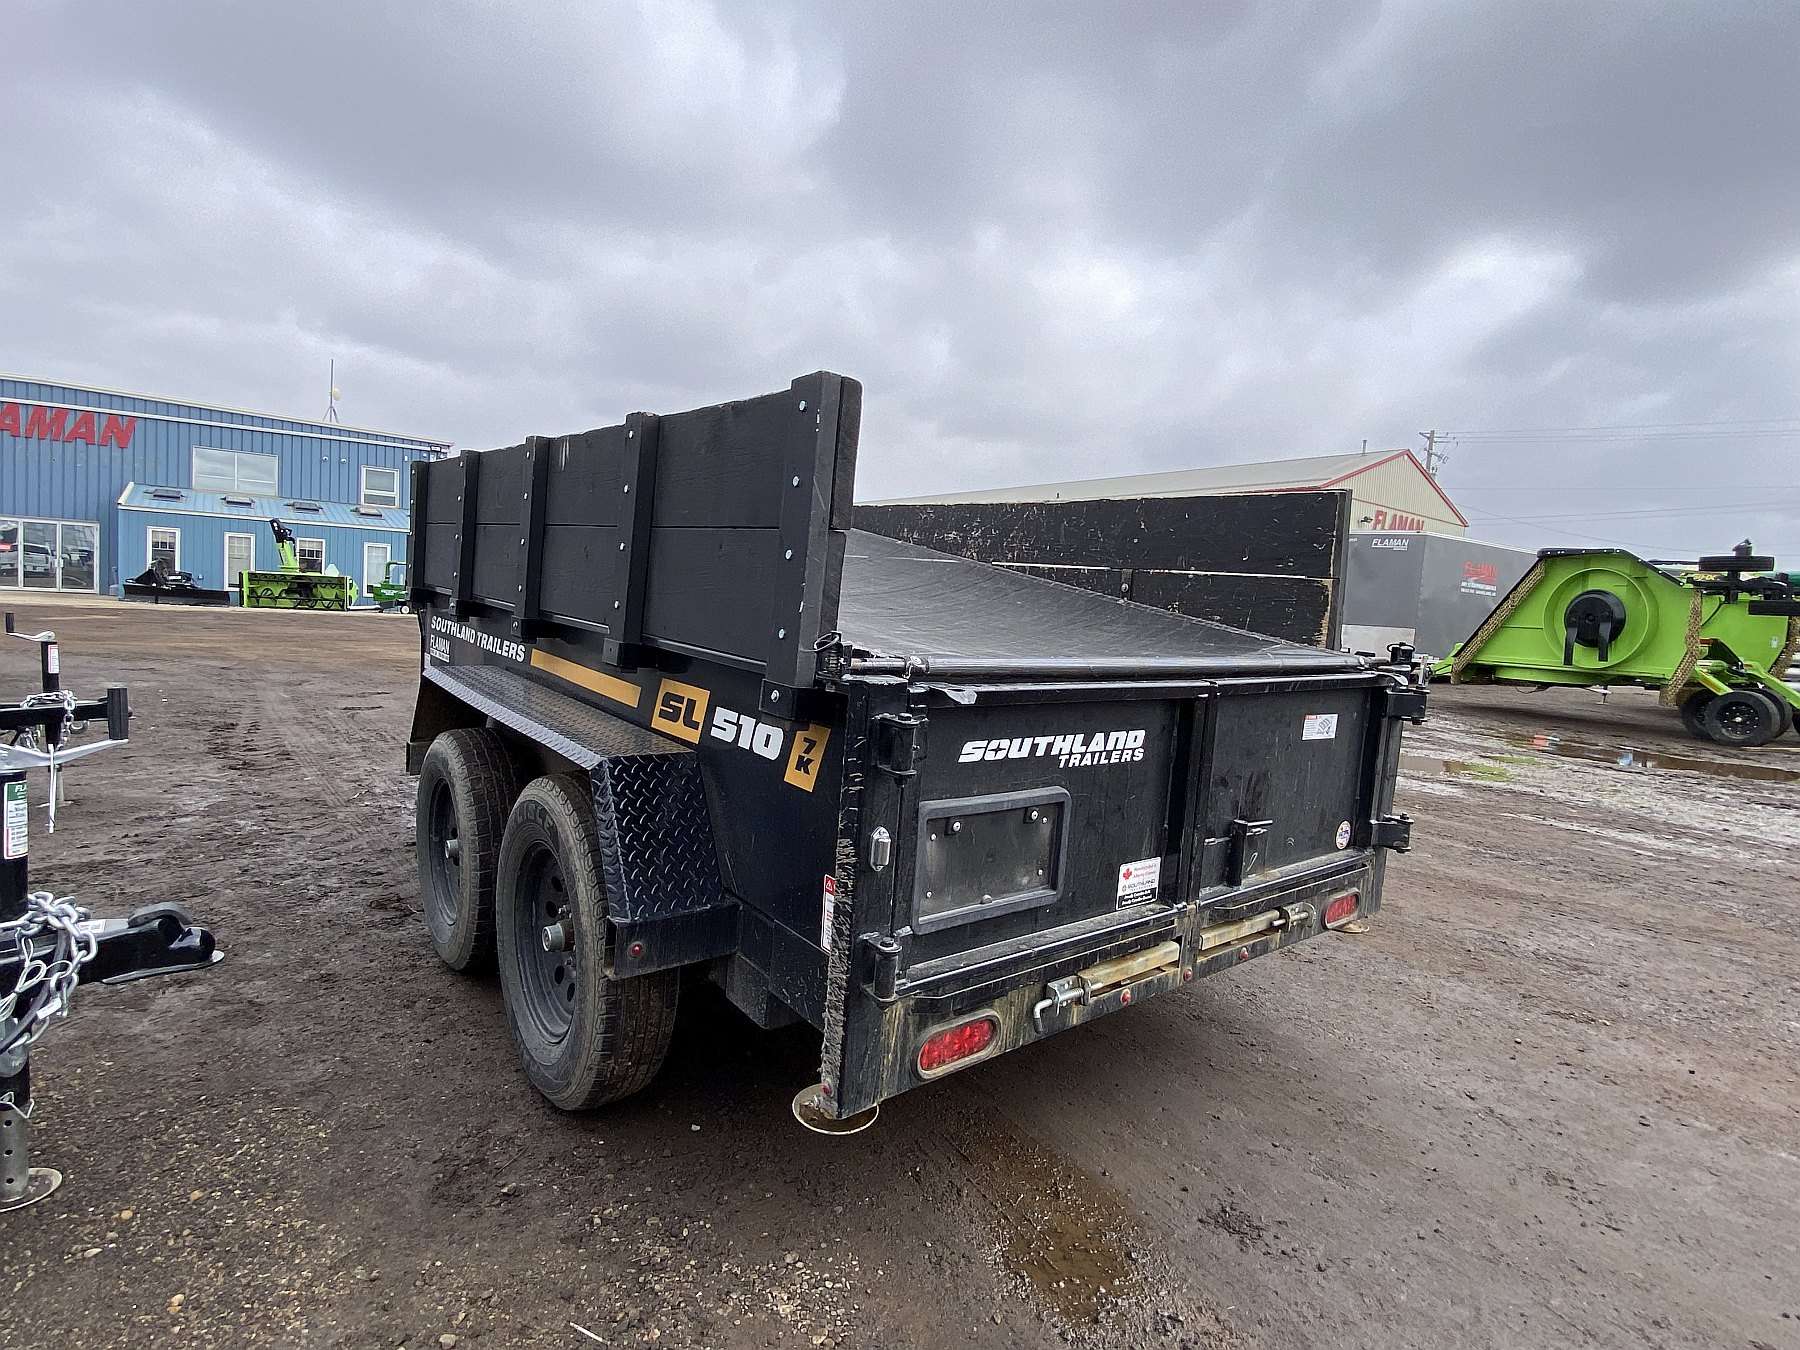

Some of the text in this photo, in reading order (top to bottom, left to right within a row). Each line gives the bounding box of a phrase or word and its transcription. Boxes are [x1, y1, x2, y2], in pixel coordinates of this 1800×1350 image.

[0, 403, 137, 448] AMAN
[1372, 510, 1425, 531] FLAMAN
[431, 615, 476, 644] SOUTHLAND
[476, 631, 526, 662] TRAILERS
[658, 691, 784, 761] SL 510
[958, 729, 1146, 763] SOUTHLAND
[1058, 748, 1145, 768] TRAILERS
